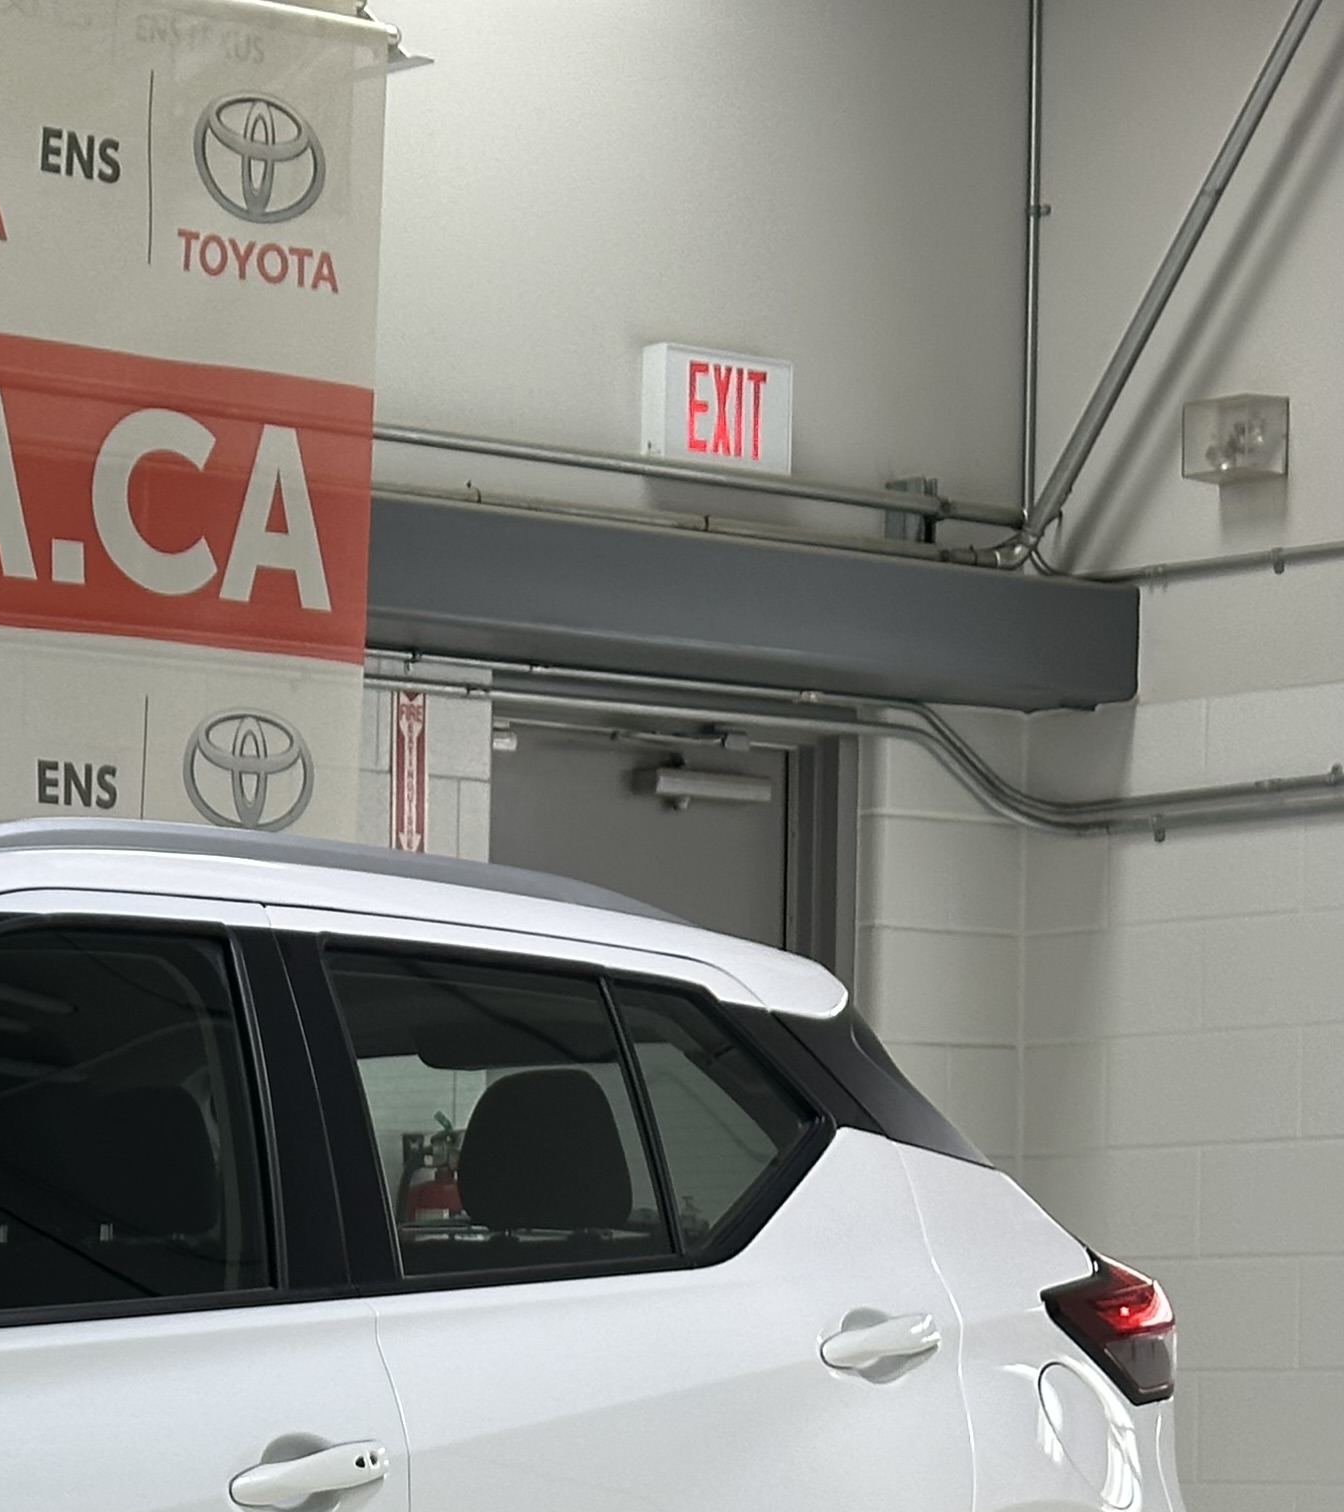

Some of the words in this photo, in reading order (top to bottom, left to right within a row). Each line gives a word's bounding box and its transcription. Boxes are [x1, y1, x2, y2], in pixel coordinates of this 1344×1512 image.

[40, 126, 122, 185] ENS
[177, 229, 339, 293] TOYOTA
[688, 361, 767, 460] EXIT
[400, 704, 424, 724] FIRE
[37, 759, 118, 810] ENS
